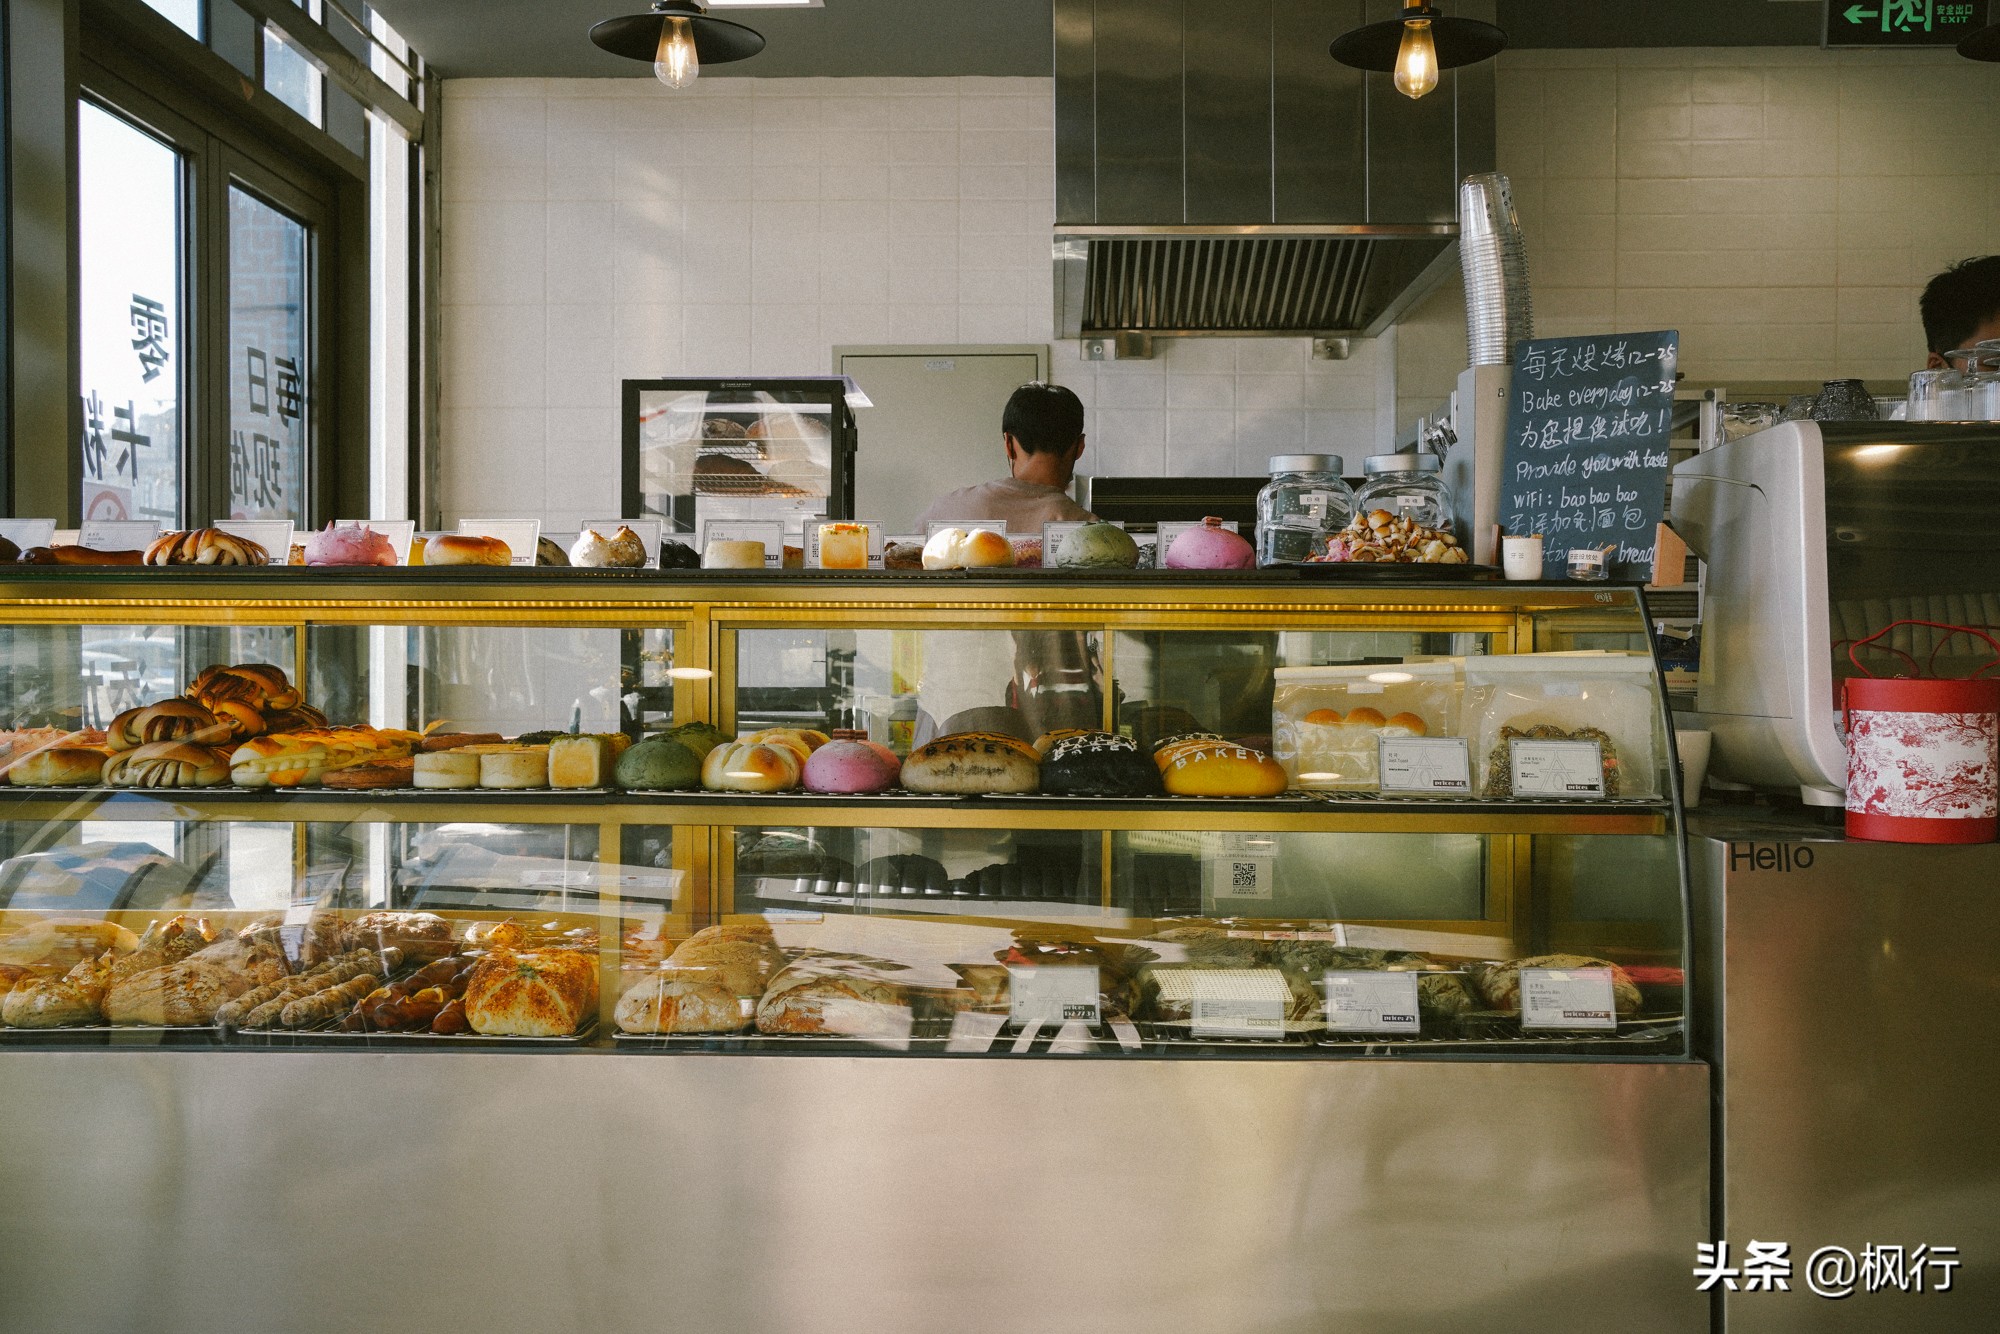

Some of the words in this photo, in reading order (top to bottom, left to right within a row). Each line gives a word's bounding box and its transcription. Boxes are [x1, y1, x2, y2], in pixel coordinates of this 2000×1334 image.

[1936, 4, 1974, 15] 安全出口
[1940, 16, 1969, 24] EXIT
[1522, 389, 1563, 413] Bake
[1516, 453, 1577, 482] Provide
[1616, 485, 1638, 501] bao
[924, 742, 1015, 757] BAKEY
[1175, 747, 1266, 771] BAKEY
[1731, 842, 1814, 872] Hello
